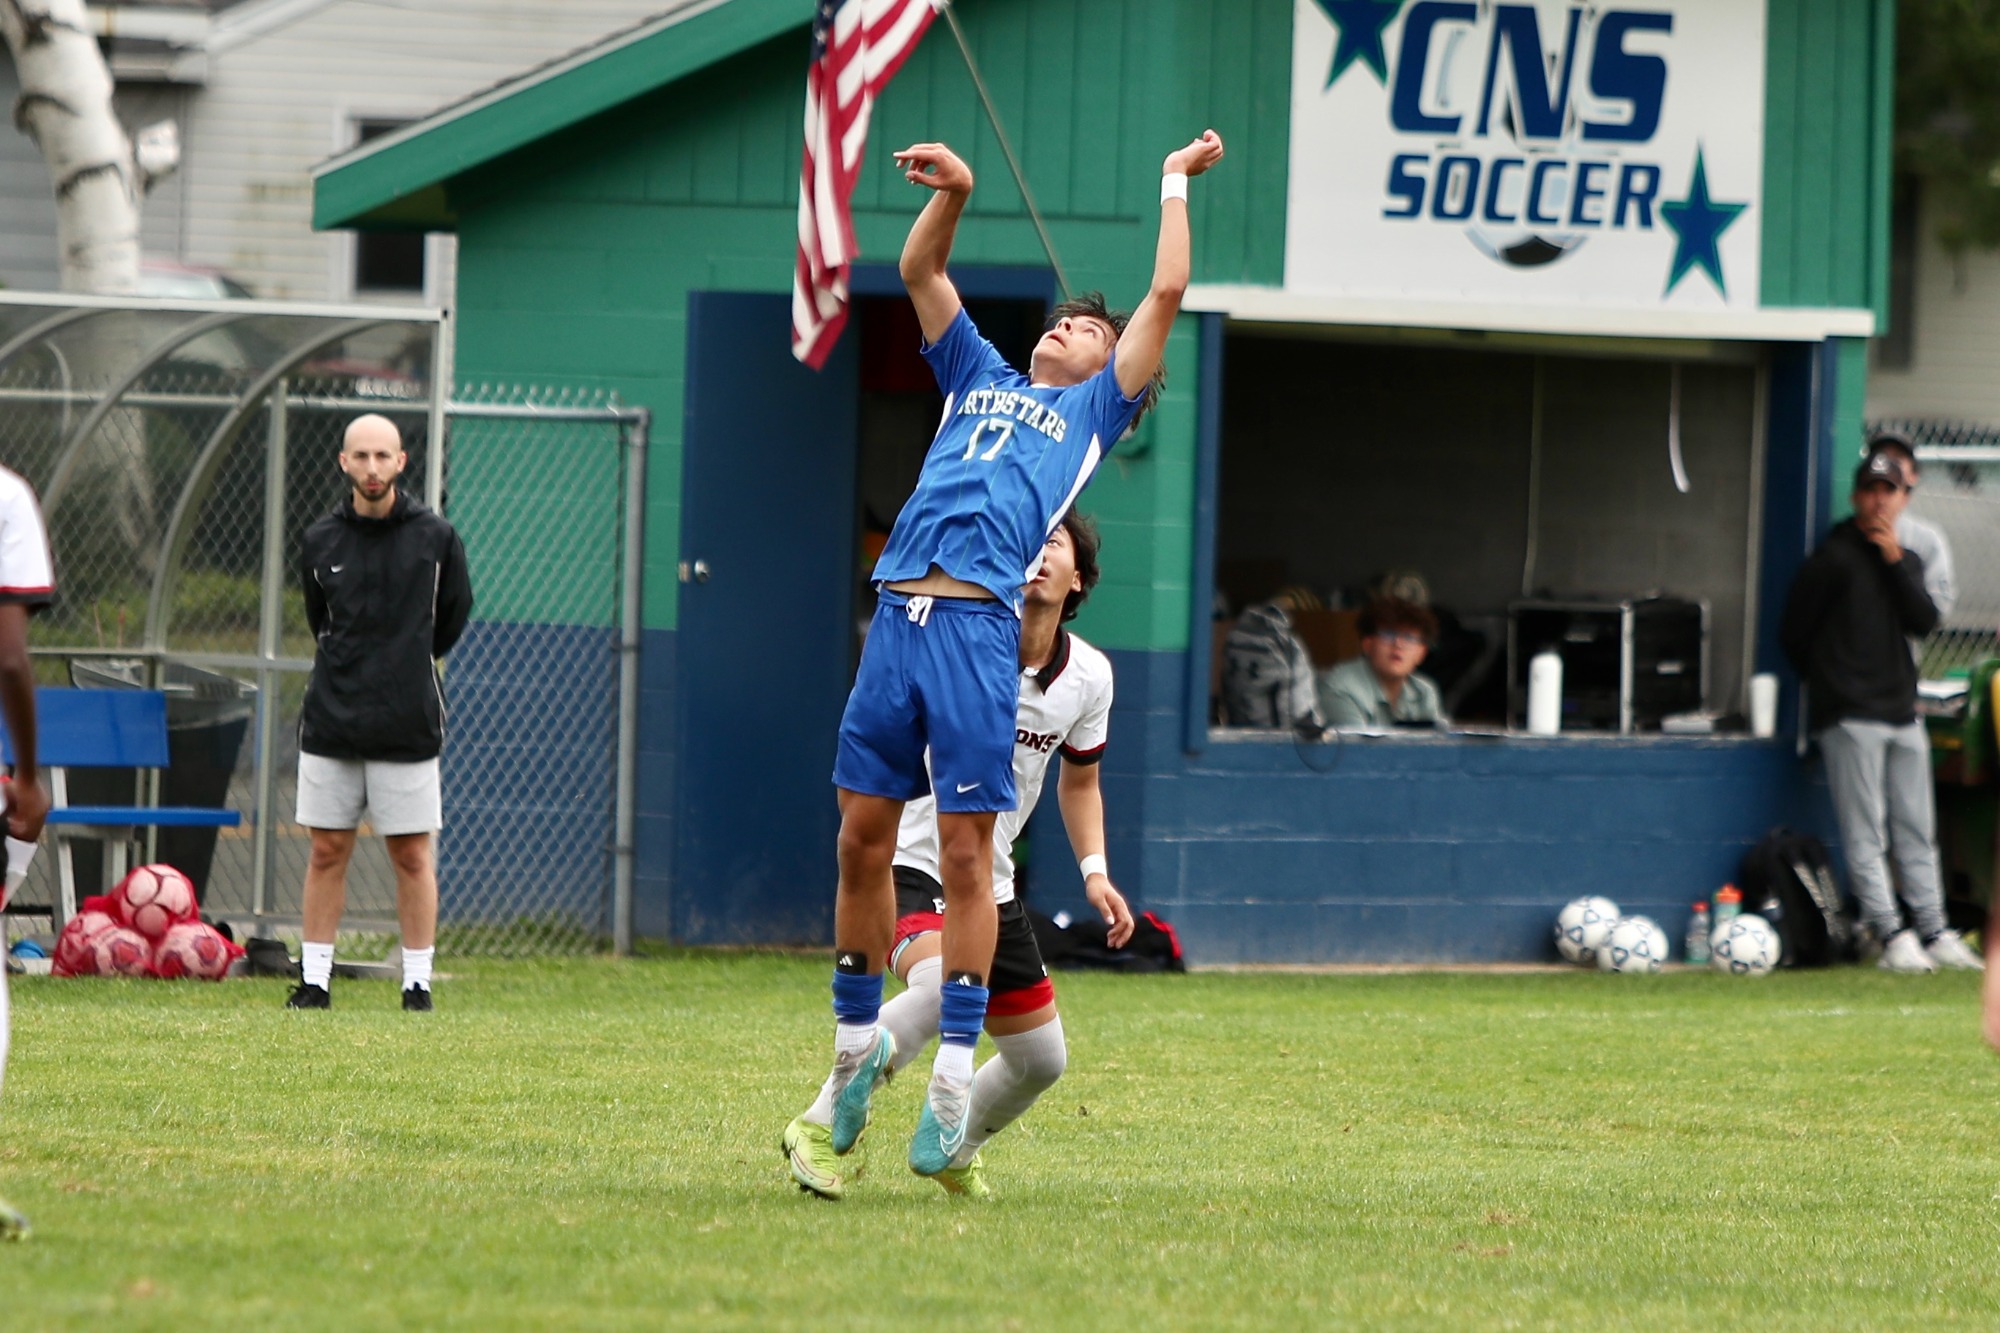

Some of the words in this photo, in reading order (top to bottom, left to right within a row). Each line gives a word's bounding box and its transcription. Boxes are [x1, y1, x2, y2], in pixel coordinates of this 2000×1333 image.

[1390, 1, 1674, 142] CNS
[1382, 153, 1661, 230] SOCCER
[957, 389, 1067, 443] RTHSTARS
[962, 417, 1014, 461] 17
